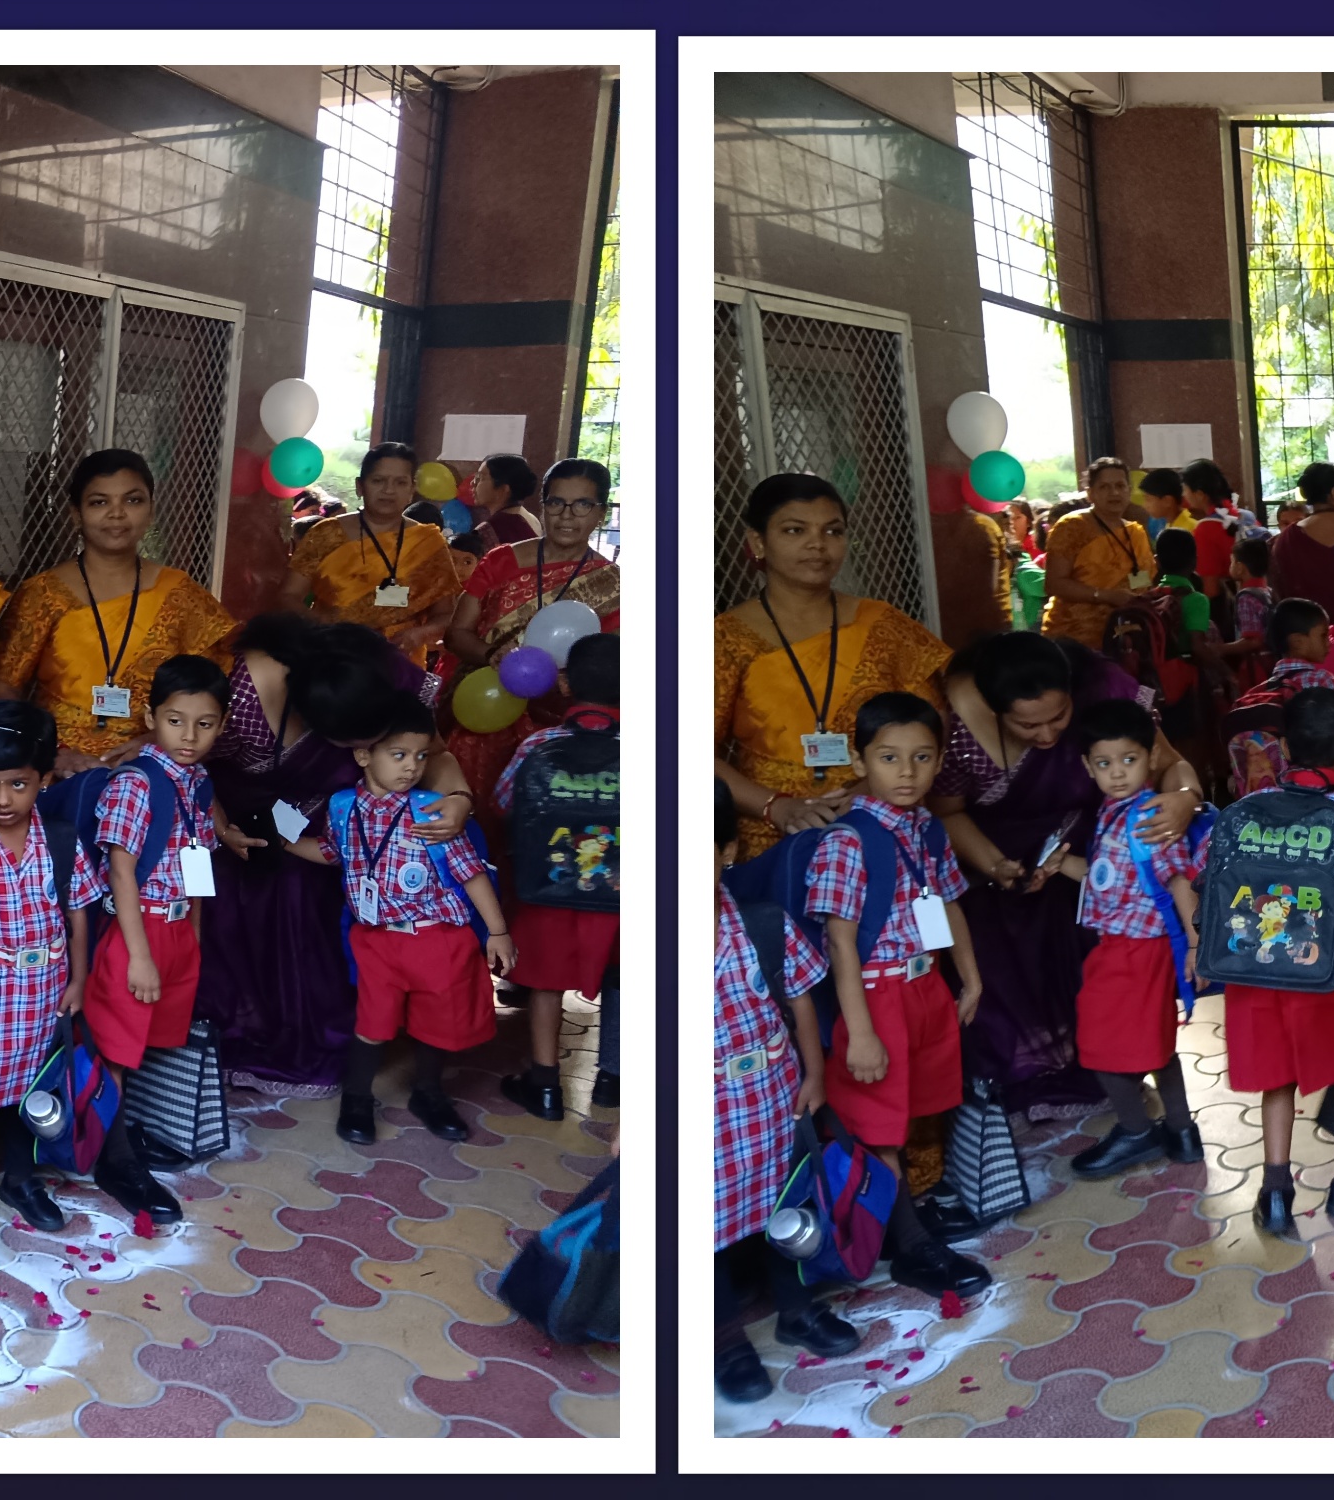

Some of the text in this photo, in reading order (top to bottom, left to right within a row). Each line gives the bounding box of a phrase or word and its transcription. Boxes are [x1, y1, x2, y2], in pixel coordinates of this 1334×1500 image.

[550, 770, 620, 793] ABC
[1238, 821, 1332, 850] ABCD
[1297, 887, 1322, 910] B
